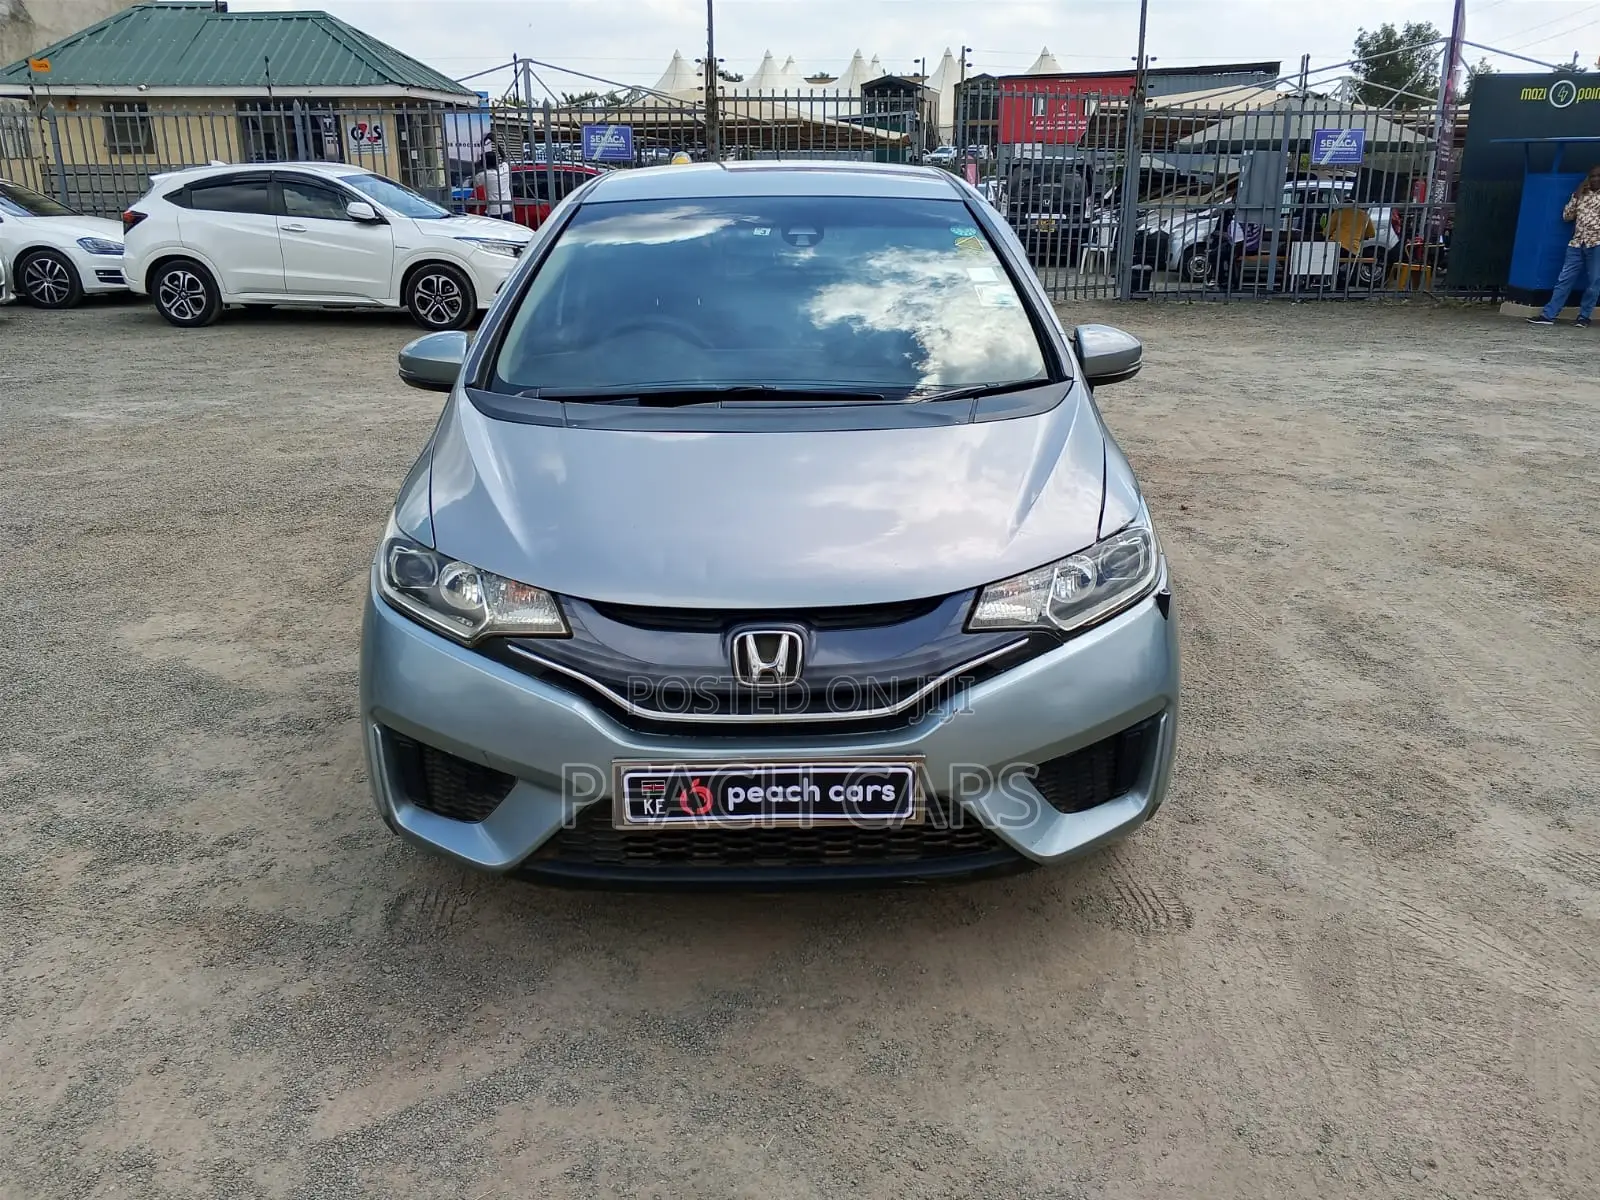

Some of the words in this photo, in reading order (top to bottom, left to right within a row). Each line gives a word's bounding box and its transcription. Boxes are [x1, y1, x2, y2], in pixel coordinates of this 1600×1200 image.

[1520, 87, 1547, 100] mazi
[728, 777, 820, 812] peach
[828, 784, 896, 803] cars
[643, 798, 665, 815] KE
